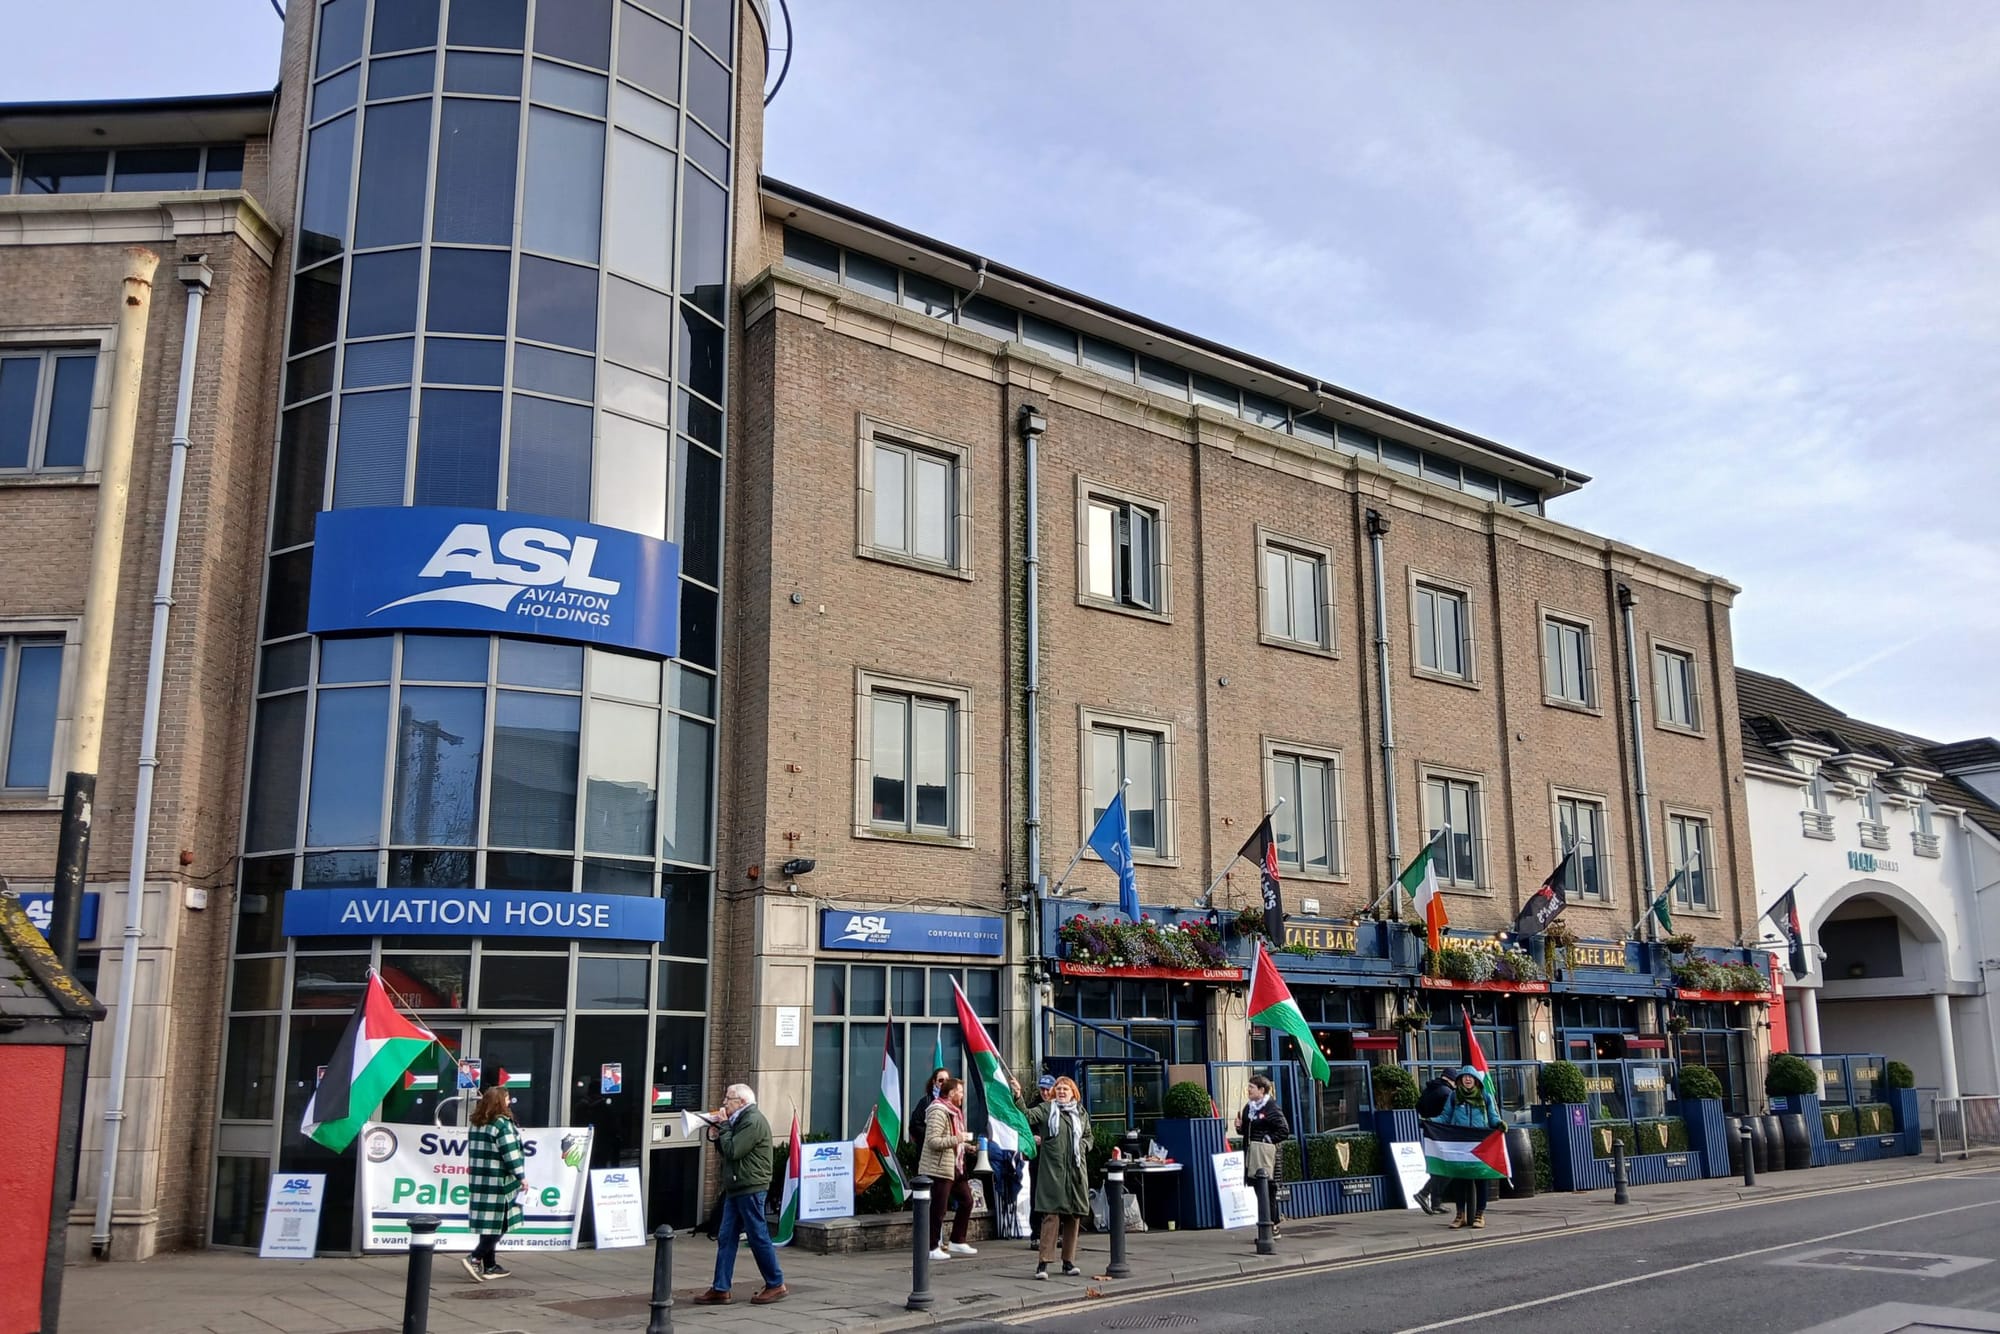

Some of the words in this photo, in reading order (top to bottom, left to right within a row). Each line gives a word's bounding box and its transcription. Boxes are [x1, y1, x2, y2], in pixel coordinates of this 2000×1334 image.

[418, 523, 621, 596] ASL
[523, 587, 610, 611] AVIATION
[516, 602, 611, 627] HOLDINGS
[340, 900, 491, 925] AVIATION
[504, 902, 610, 928] HOUSE
[844, 915, 892, 935] ASL
[928, 930, 970, 939] CORPORATE
[973, 932, 999, 940] OFFICE
[1285, 928, 1320, 948] CAFE
[1326, 930, 1356, 949] BAR
[1575, 948, 1600, 964] CAFE
[1603, 949, 1625, 966] BAR
[1065, 962, 1106, 973] GUINNESS
[1203, 968, 1239, 978] GUINNESS
[814, 1147, 842, 1157] ASL
[1223, 1157, 1242, 1167] ASL
[283, 1179, 312, 1189] ASL
[603, 1173, 629, 1183] ASL
[381, 1236, 408, 1244] want
[500, 1238, 524, 1246] want
